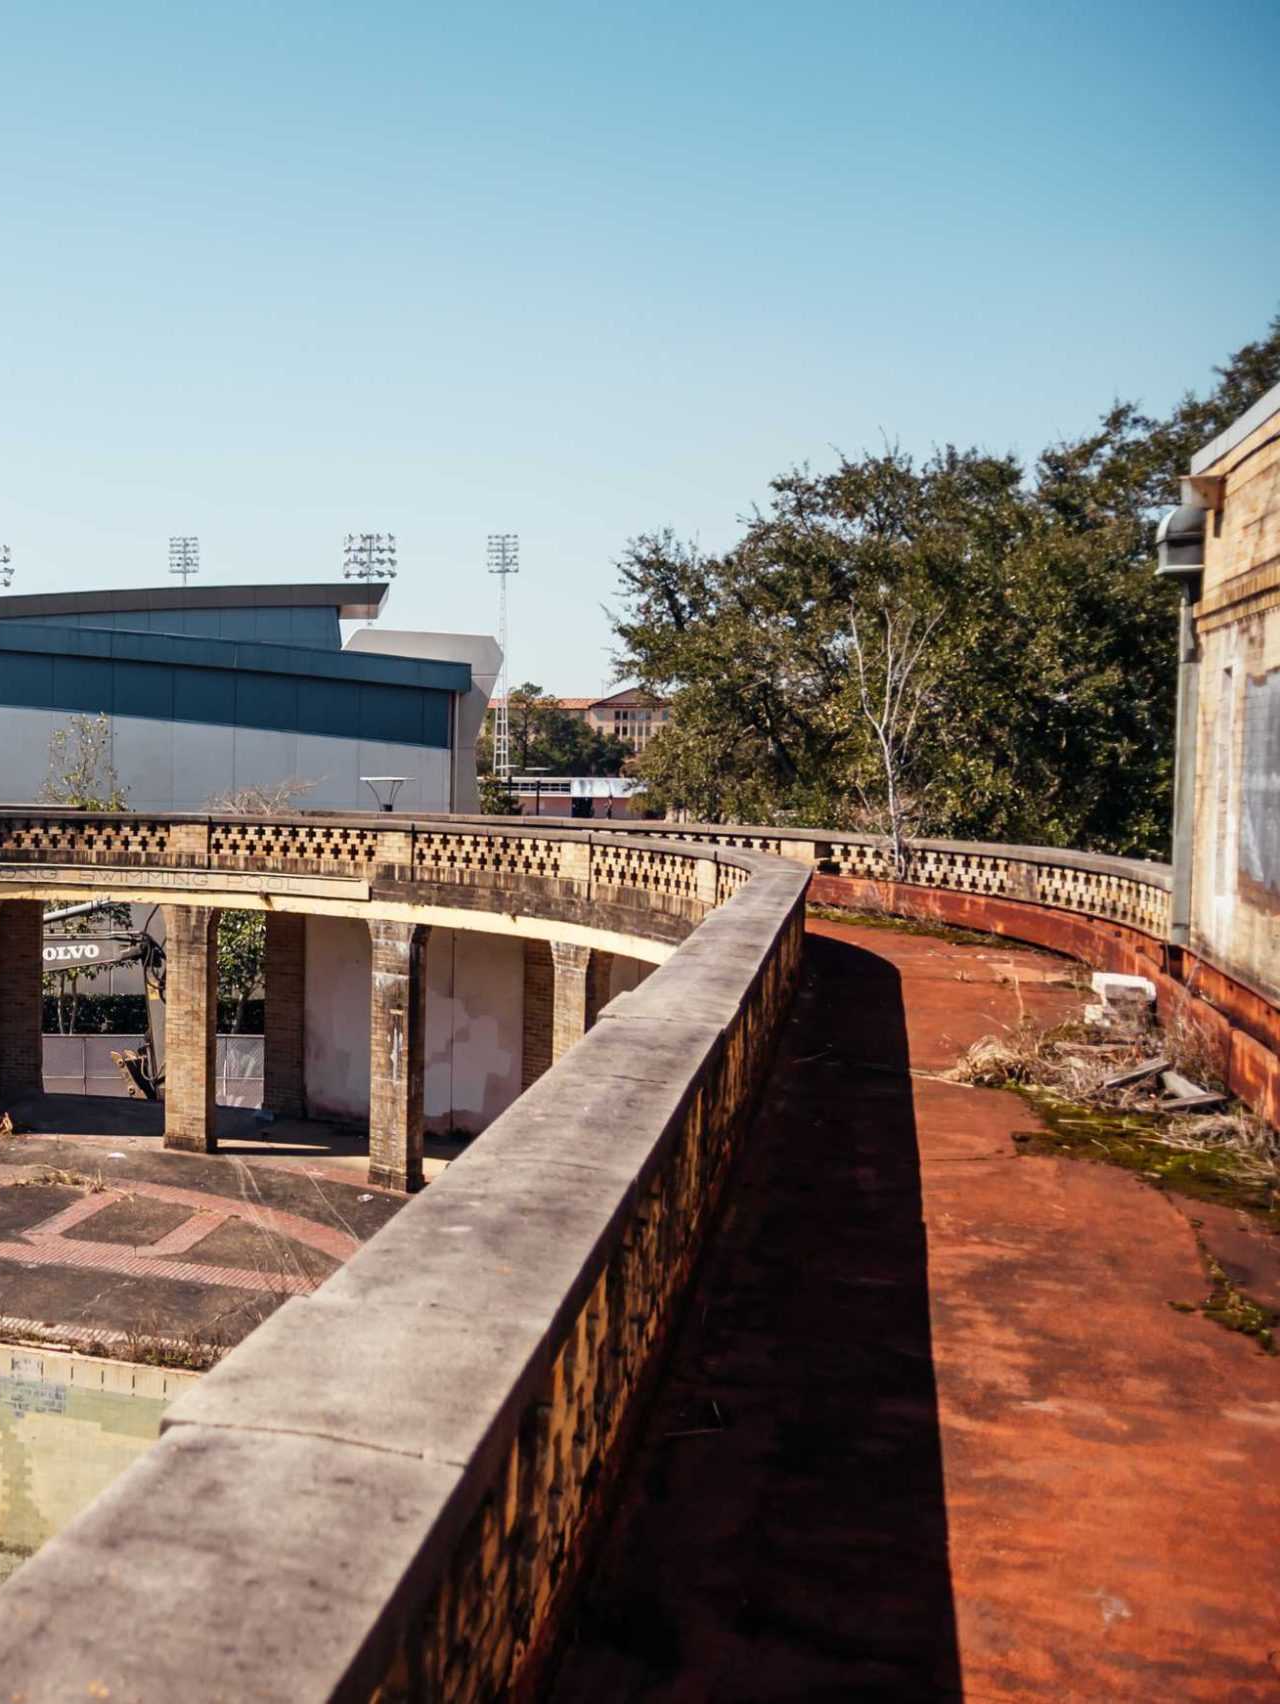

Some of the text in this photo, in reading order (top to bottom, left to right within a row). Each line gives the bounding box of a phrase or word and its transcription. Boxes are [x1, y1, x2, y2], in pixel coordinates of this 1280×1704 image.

[79, 869, 209, 887] SWIMMING
[226, 874, 302, 891] POOL
[42, 944, 100, 961] OLVO
